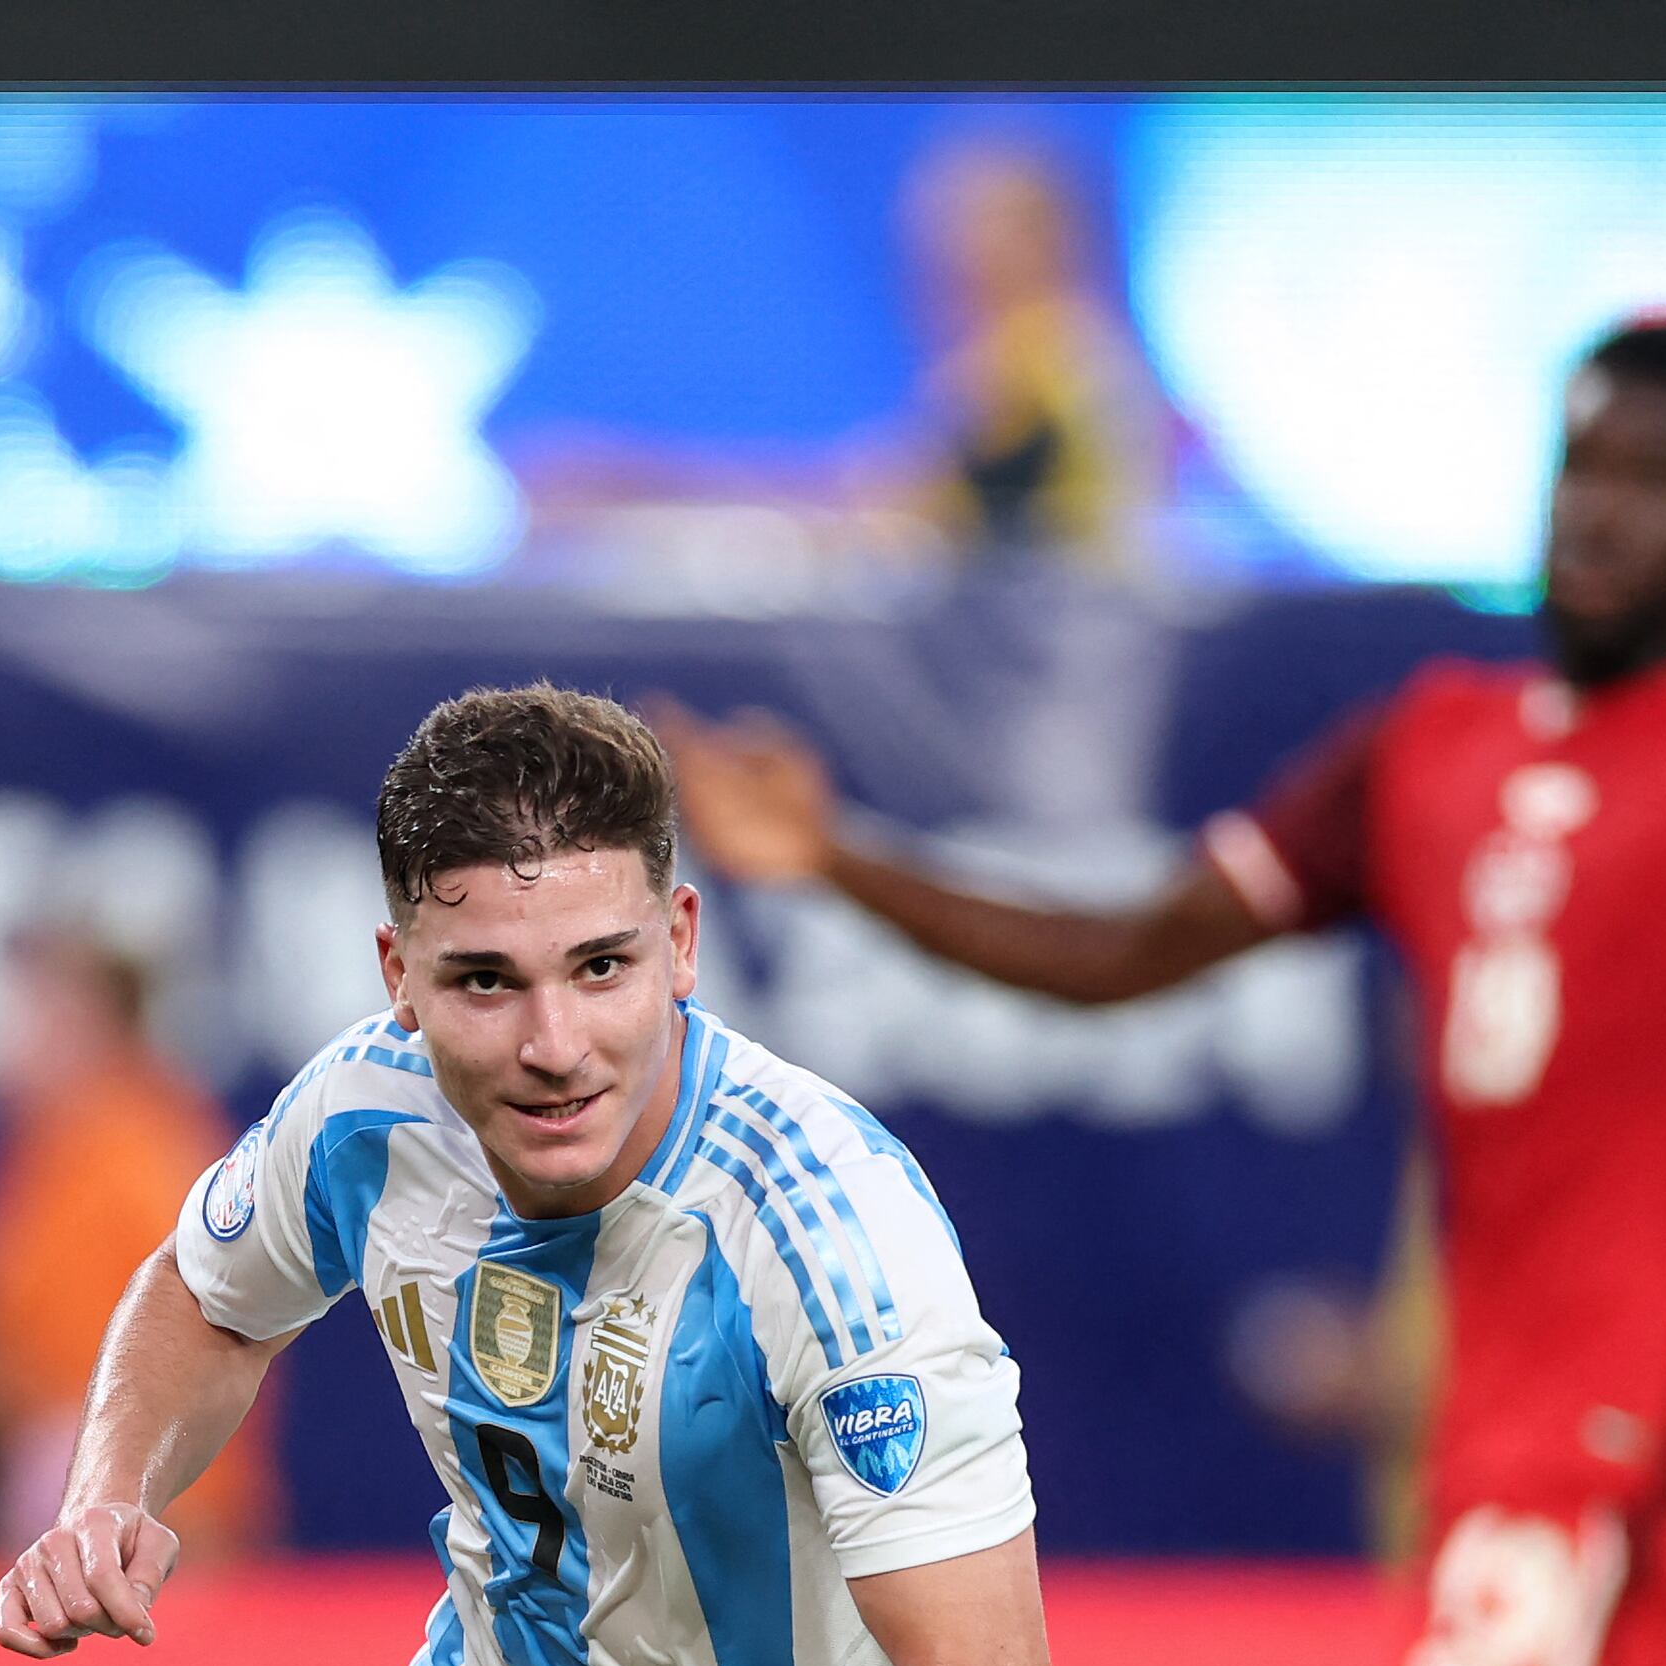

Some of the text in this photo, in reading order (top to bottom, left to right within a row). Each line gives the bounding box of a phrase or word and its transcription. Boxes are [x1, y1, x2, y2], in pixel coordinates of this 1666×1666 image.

[593, 1356, 629, 1421] AFA
[834, 1400, 913, 1436] VIBRA
[851, 1421, 916, 1445] CONTINENTE
[475, 1423, 565, 1579] 9
